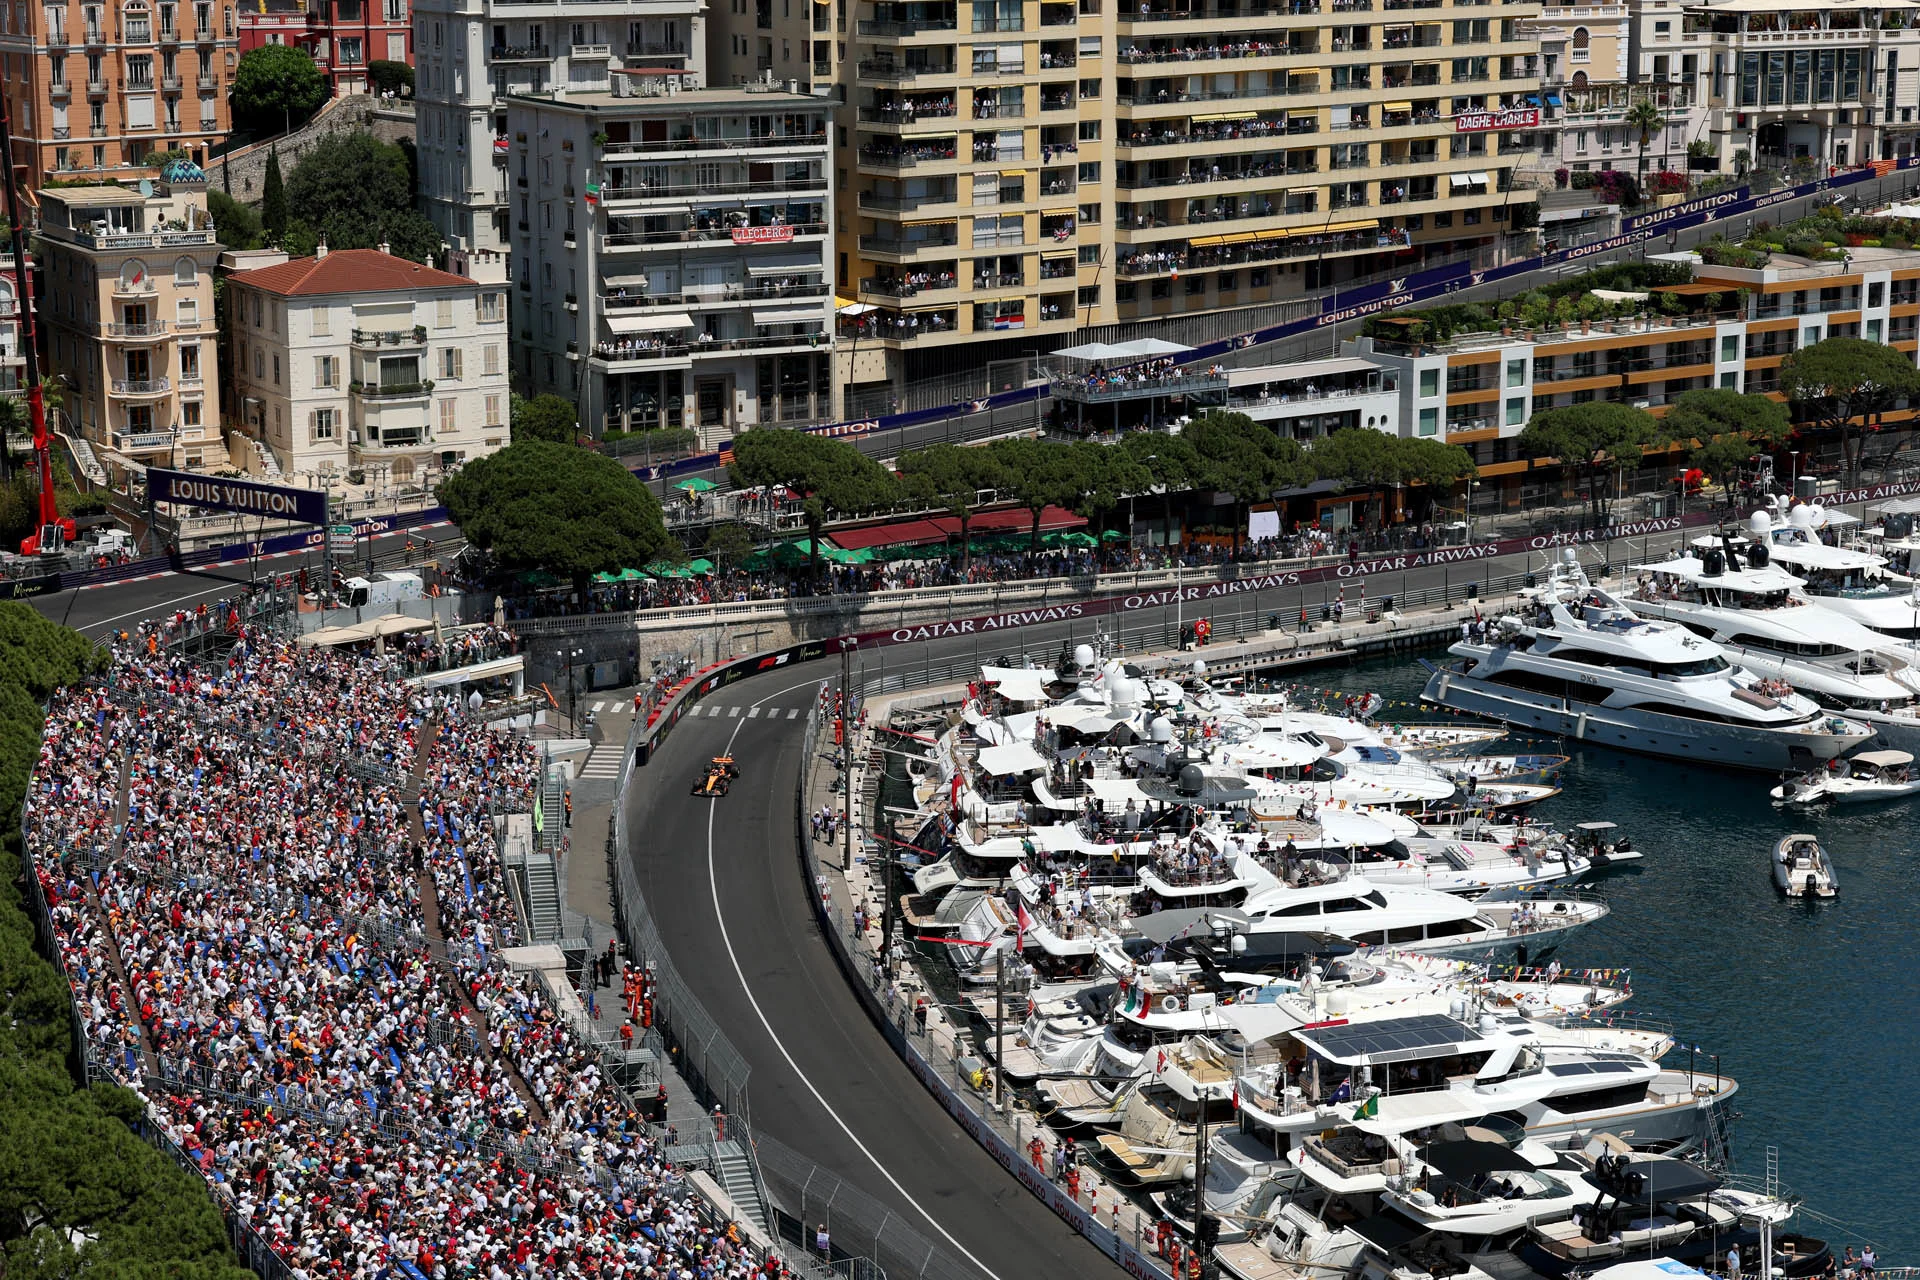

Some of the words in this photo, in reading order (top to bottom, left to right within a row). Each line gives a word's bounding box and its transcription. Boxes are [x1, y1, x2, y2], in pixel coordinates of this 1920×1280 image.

[1458, 115, 1492, 130] DAGHE
[1494, 111, 1535, 127] CHARLIE
[1634, 208, 1677, 229] LOUIS
[1680, 191, 1738, 214] VUITTON
[1756, 198, 1773, 208] LOUIS
[1772, 190, 1795, 203] VUITTON
[741, 227, 785, 239] LECLERC
[1568, 243, 1603, 259] LOUIS
[1318, 308, 1357, 326] LOUIS
[805, 420, 880, 437] UITTON
[171, 478, 221, 504] LOUIS
[224, 486, 298, 515] VUITTON
[1811, 489, 1869, 507] QATAR
[1531, 529, 1595, 549] QATAR
[1601, 517, 1682, 539] AIRWAYS
[1336, 557, 1407, 577] QATAR
[1412, 543, 1498, 567] AIRWAYS
[1124, 587, 1201, 609] QATAR
[1205, 572, 1300, 597] AIRWAYS
[892, 619, 976, 642] QATAR
[981, 604, 1082, 630] AIRWAYS
[985, 1138, 1011, 1169] MONACO
[1018, 1167, 1046, 1200] MONACO
[1054, 1199, 1084, 1233] MONACO
